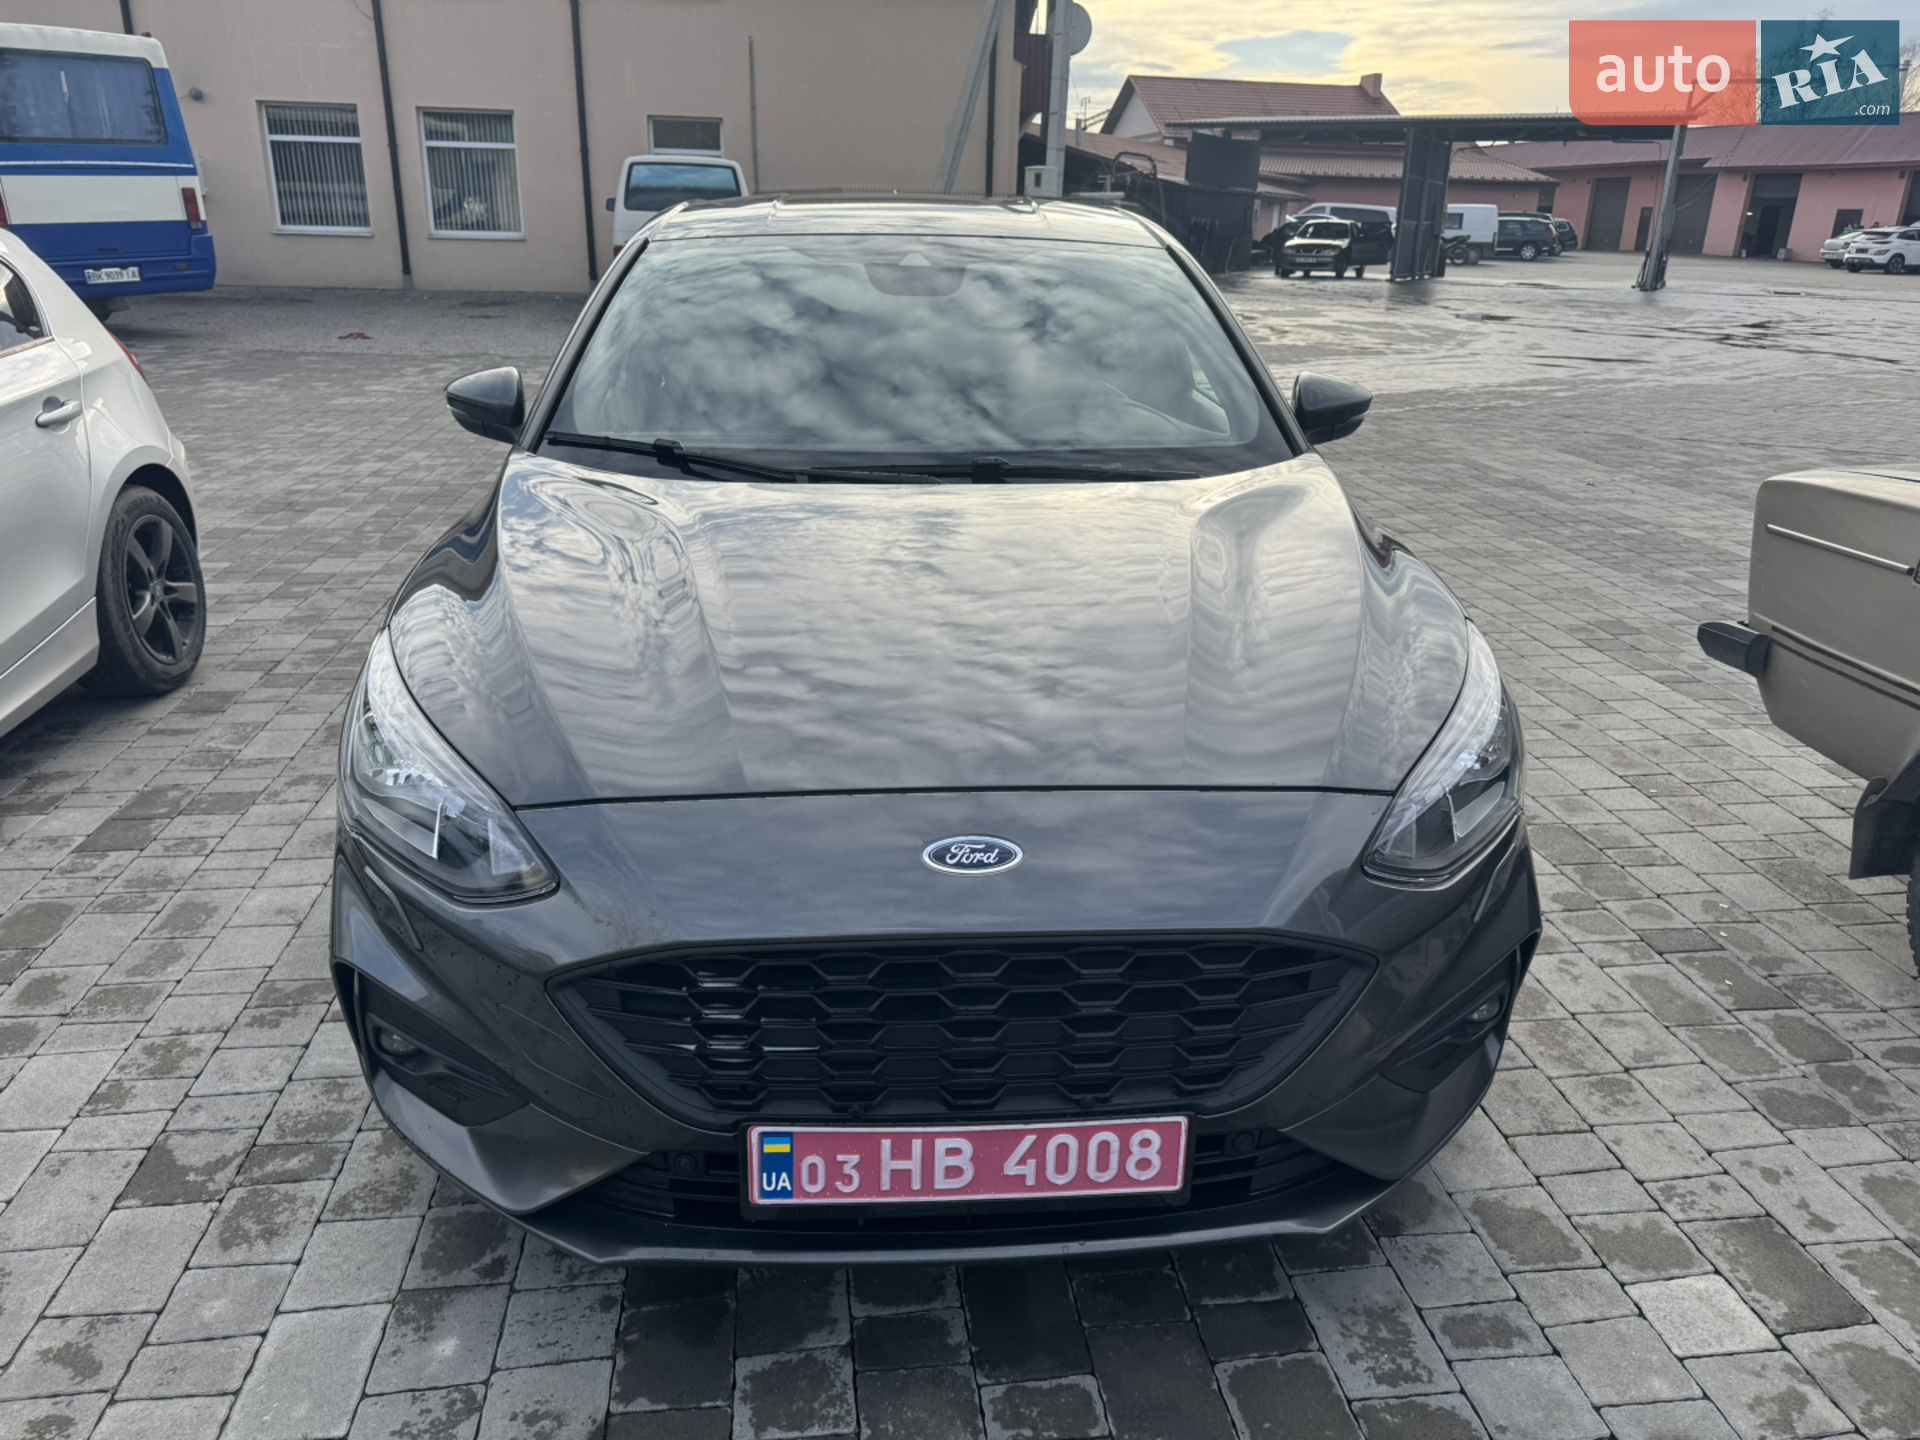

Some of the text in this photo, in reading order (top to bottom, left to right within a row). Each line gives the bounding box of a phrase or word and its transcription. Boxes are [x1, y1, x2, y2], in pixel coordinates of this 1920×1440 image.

[945, 843, 999, 865] Ford
[800, 1128, 1163, 1194] 03 HB 4008
[762, 1171, 792, 1192] UA
